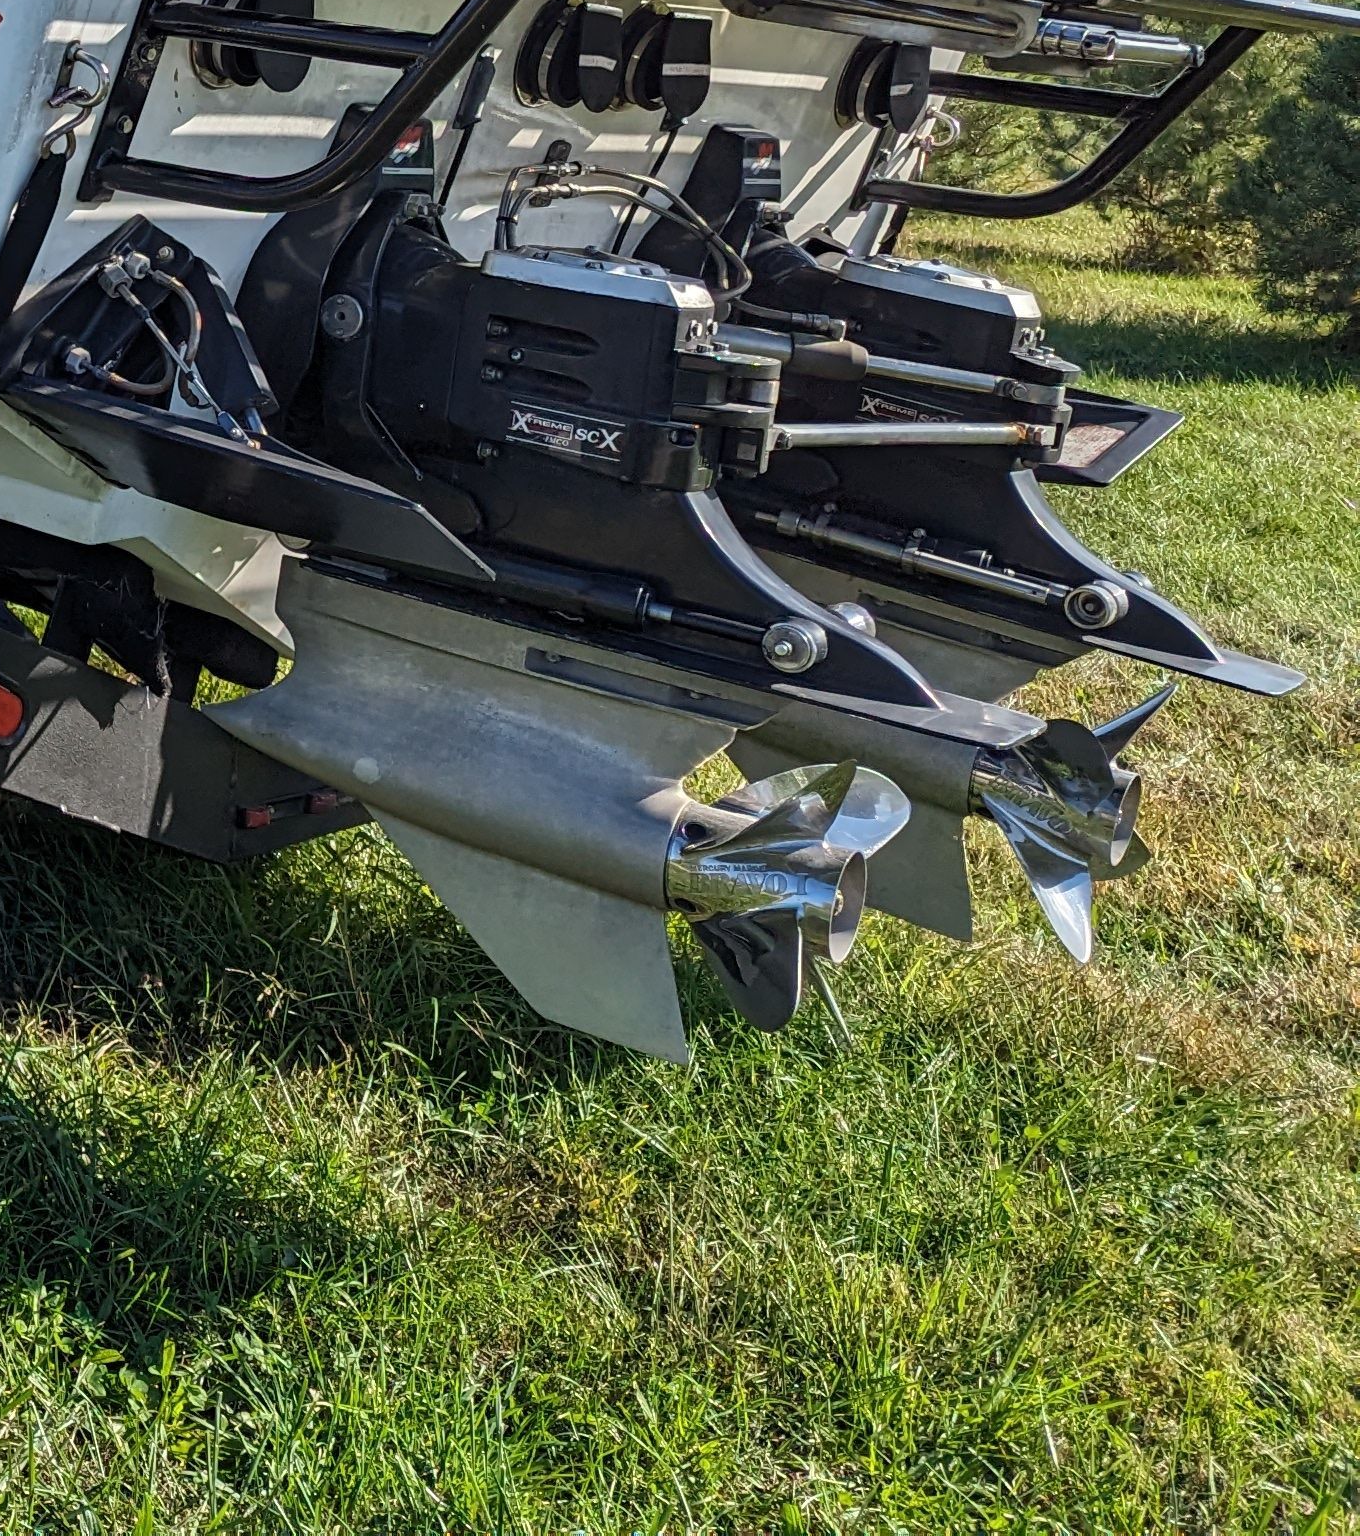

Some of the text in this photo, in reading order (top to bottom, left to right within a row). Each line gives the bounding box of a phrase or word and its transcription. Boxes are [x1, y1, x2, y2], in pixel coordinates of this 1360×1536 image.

[574, 427, 623, 453] SCX
[689, 864, 767, 872] MERCURY MARINE
[689, 872, 788, 896] BRAVO
